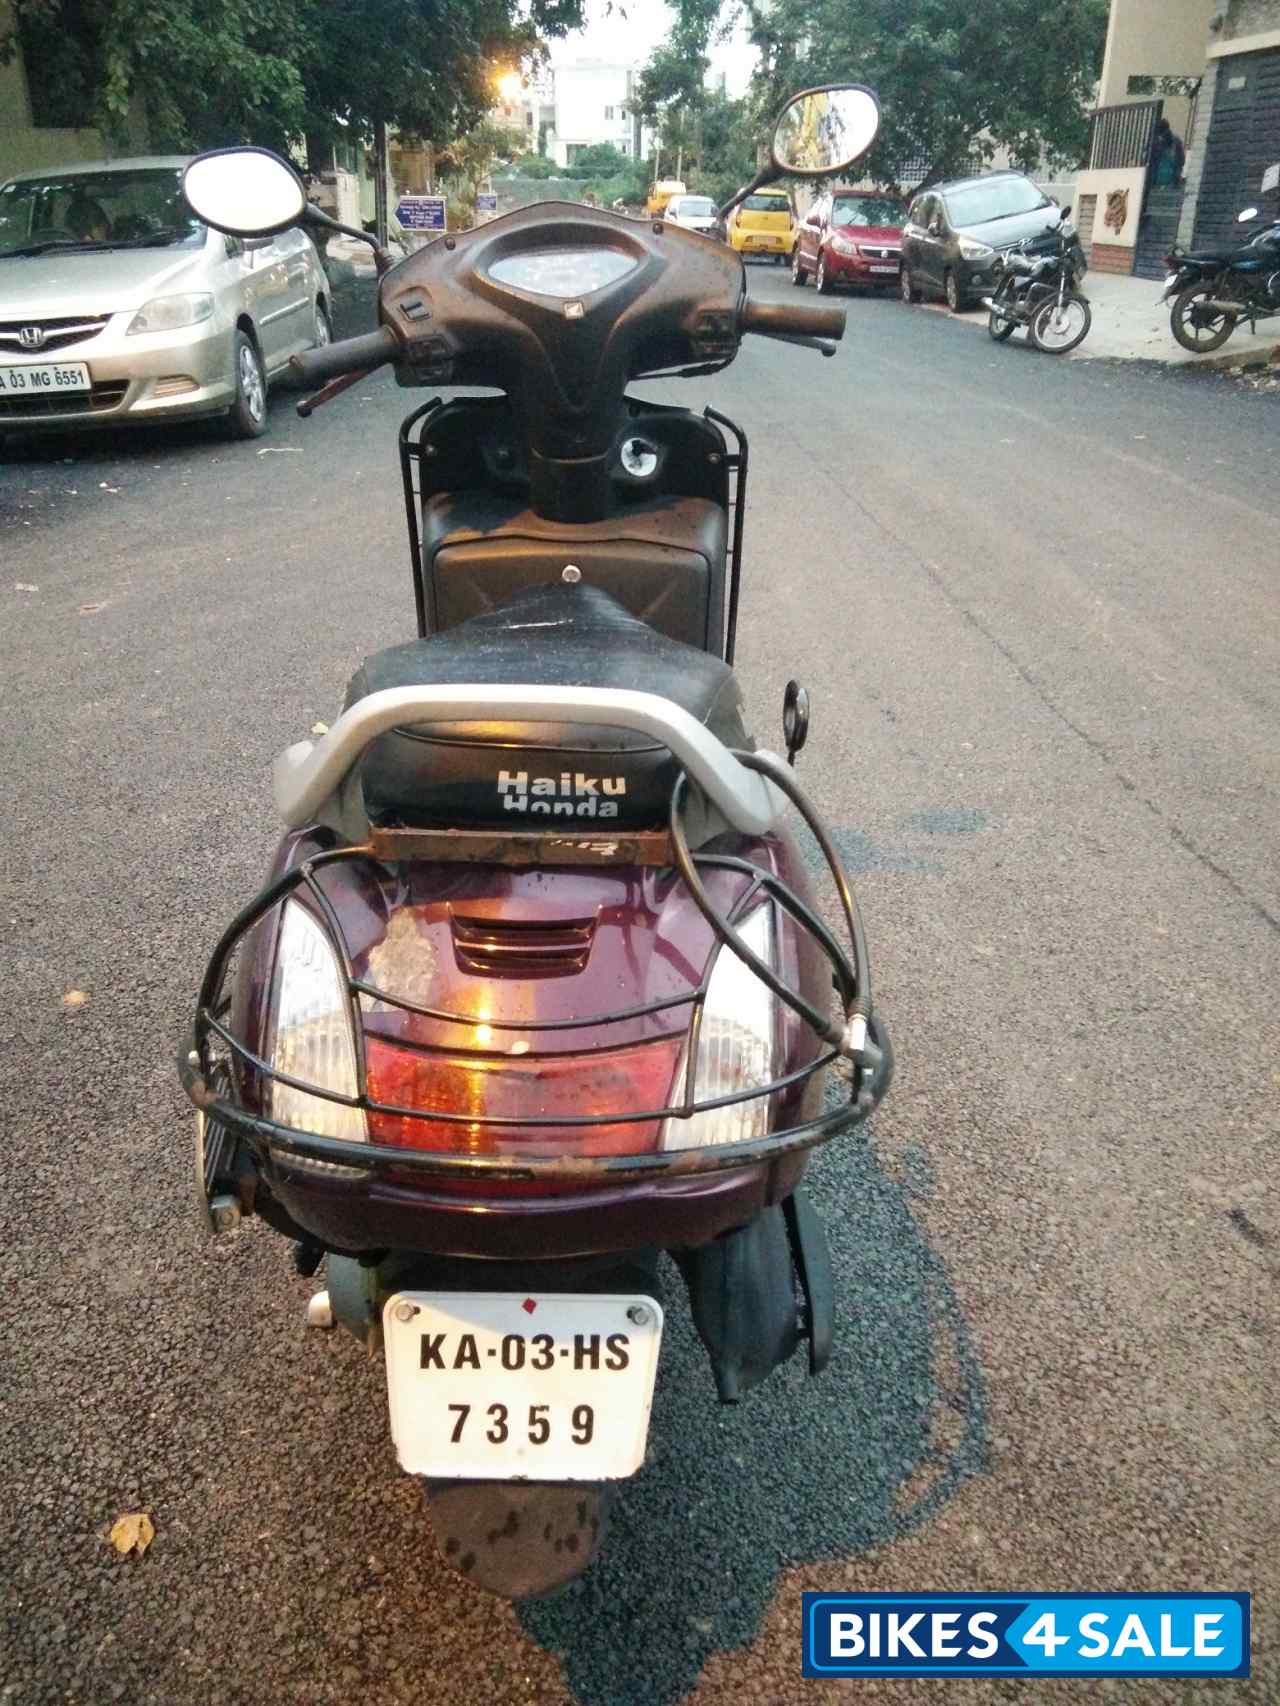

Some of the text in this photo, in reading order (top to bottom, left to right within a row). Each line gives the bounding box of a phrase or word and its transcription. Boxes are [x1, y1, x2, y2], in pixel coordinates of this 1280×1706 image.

[9, 373, 26, 388] 03
[30, 371, 50, 387] MG
[54, 369, 84, 386] 6551
[498, 770, 626, 796] Haiku
[503, 794, 618, 817] Honda
[448, 1403, 594, 1445] 7359
